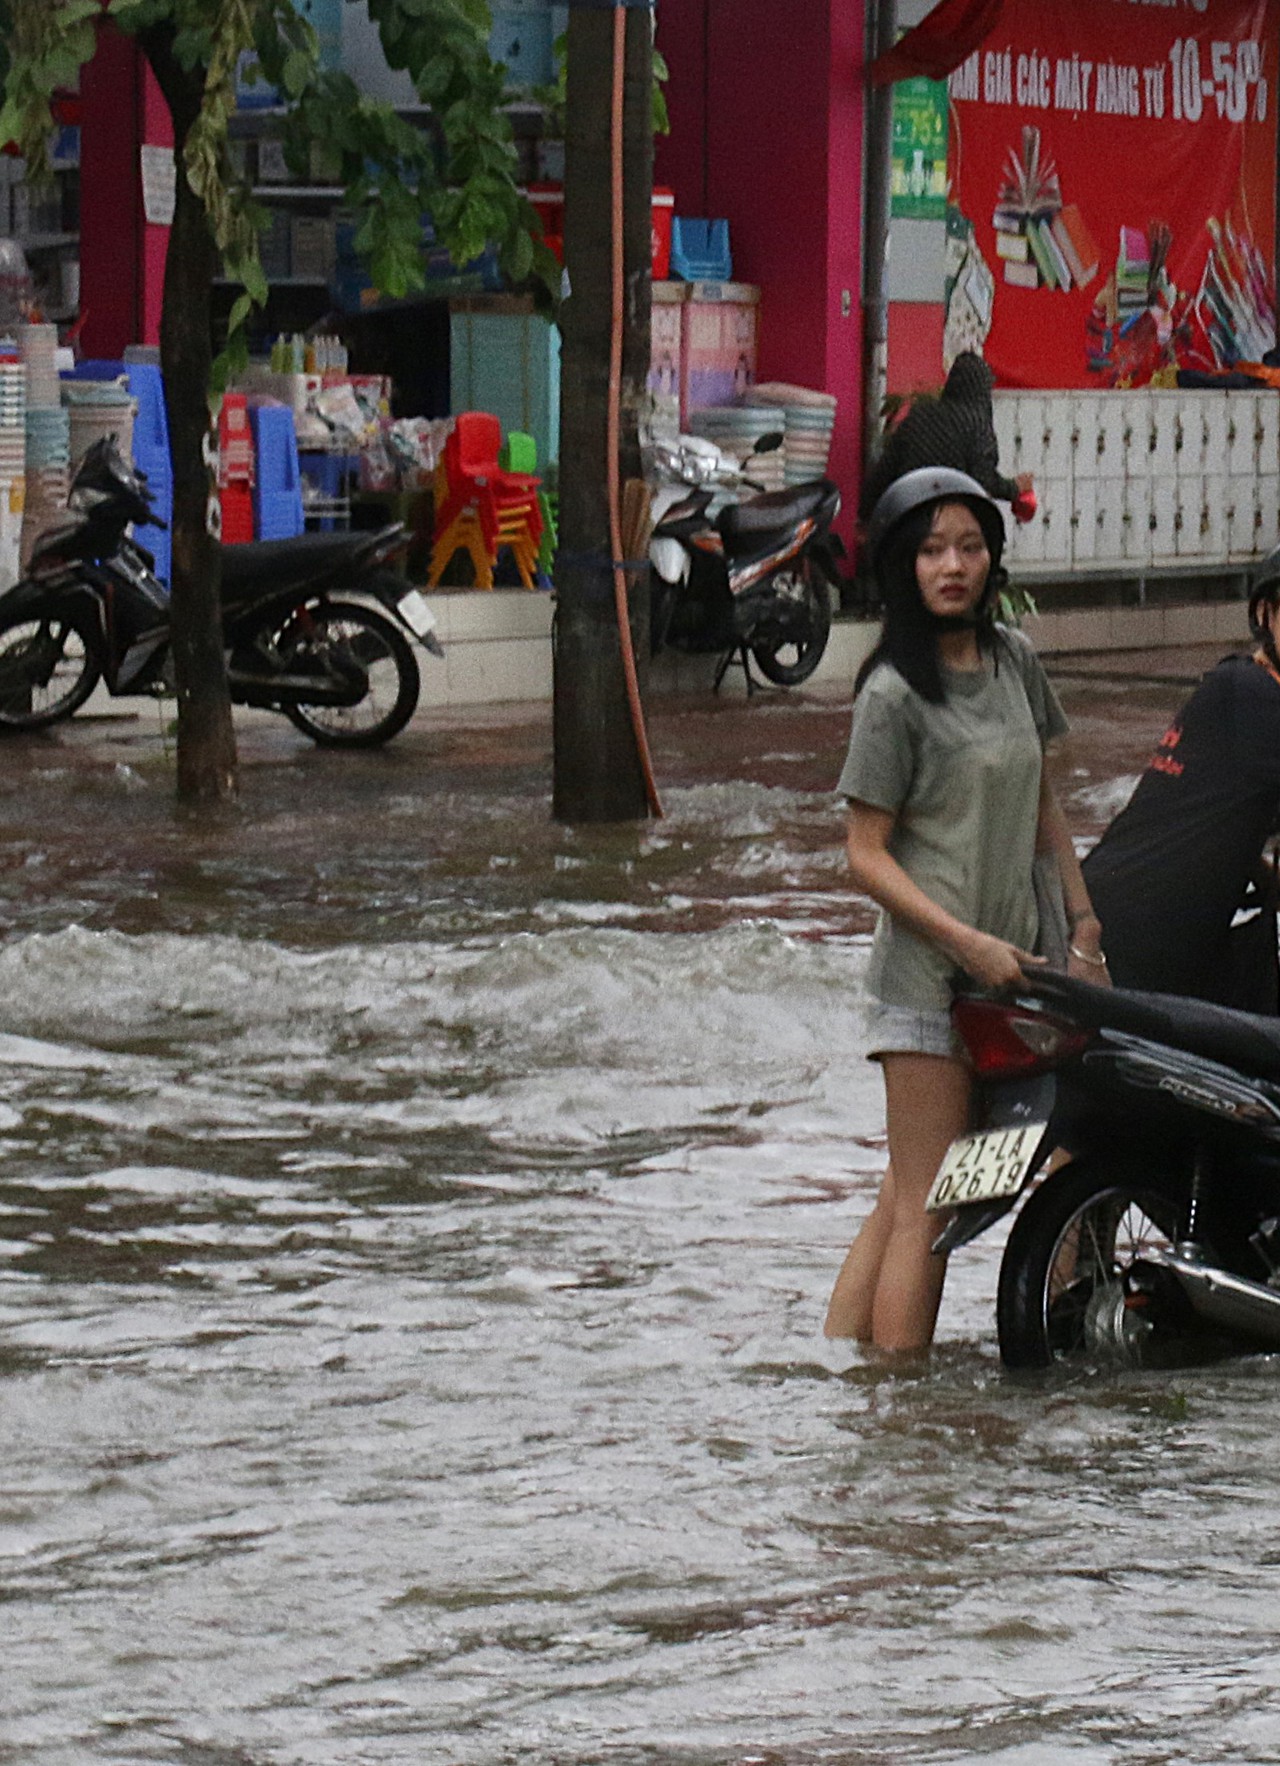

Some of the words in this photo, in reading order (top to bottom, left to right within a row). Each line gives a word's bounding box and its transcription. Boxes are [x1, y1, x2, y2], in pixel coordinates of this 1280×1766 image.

[985, 45, 1012, 105] GIÁ
[1017, 48, 1050, 109] CÁC
[1054, 52, 1093, 121] MẶT
[1094, 56, 1139, 116] HÀNG
[1169, 37, 1268, 122] 10-50%
[956, 1128, 1026, 1168] 21-LA
[935, 1160, 1025, 1203] 026.19
